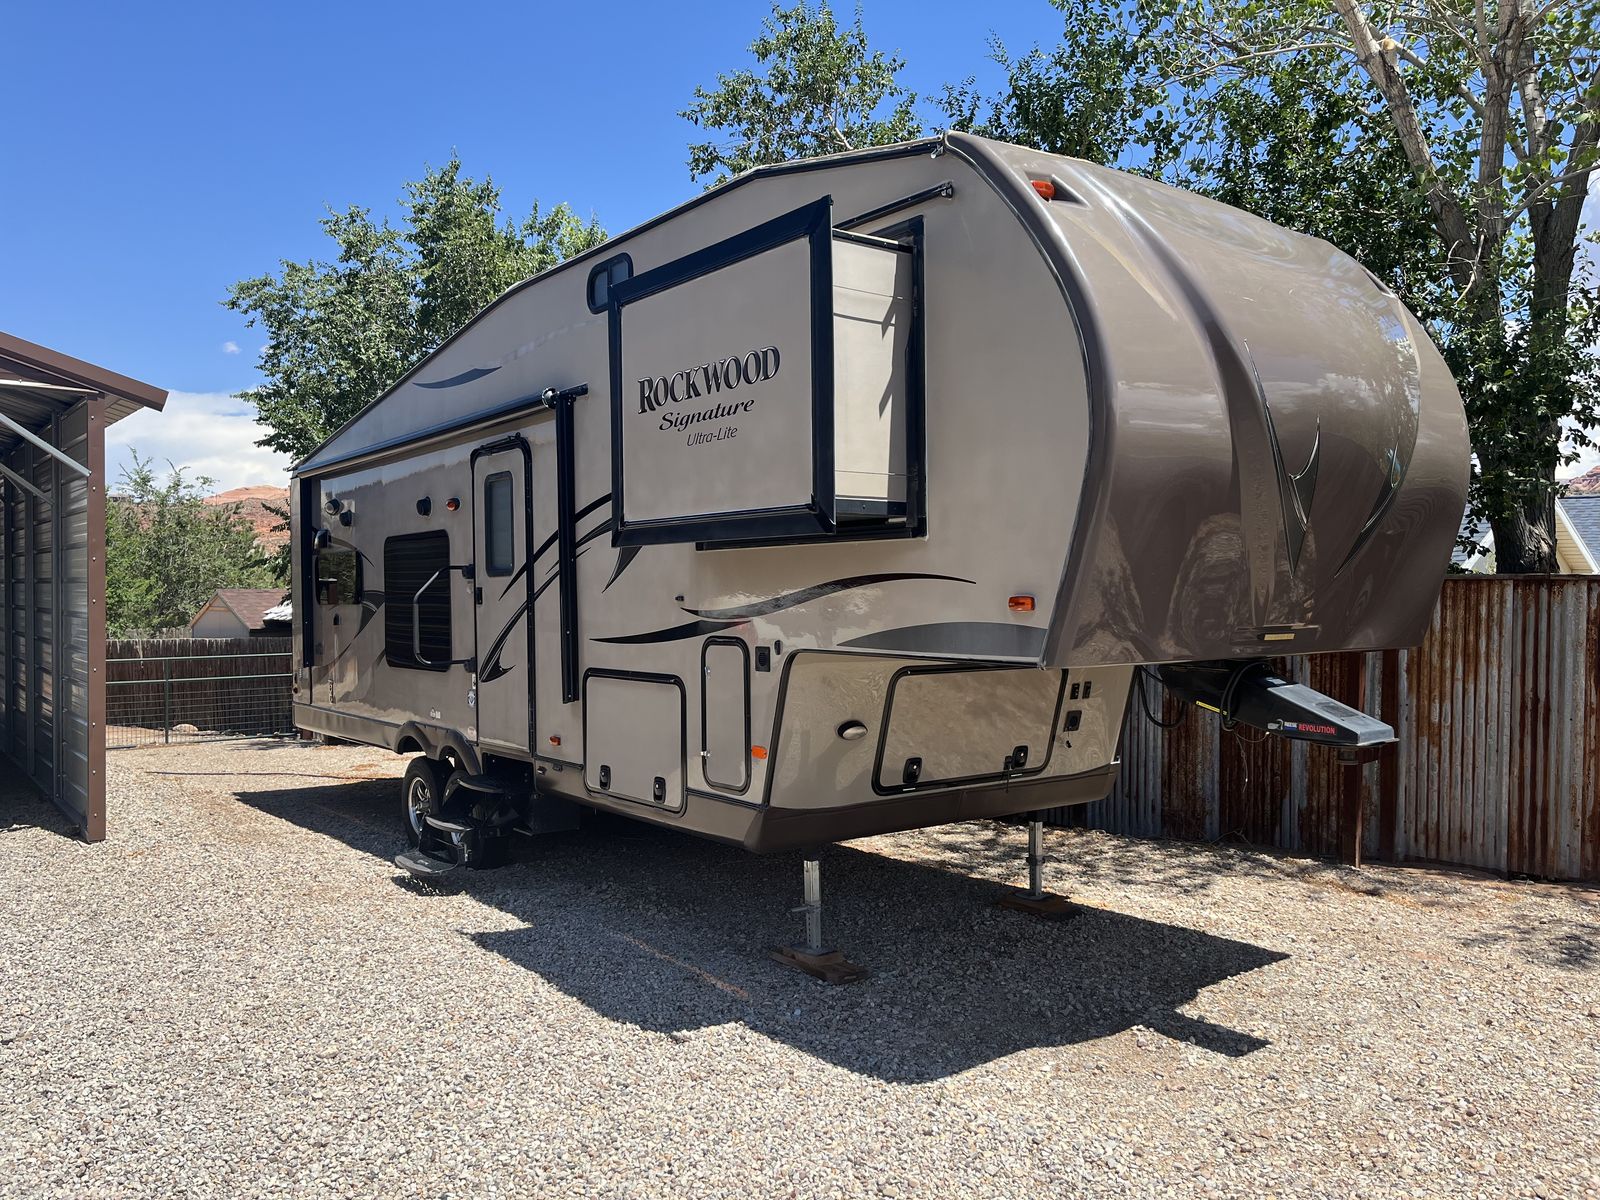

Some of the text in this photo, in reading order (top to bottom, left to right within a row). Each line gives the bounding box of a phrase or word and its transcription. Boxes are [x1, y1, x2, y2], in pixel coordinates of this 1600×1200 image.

[637, 345, 781, 414] ROCKWOOD
[659, 399, 755, 432] Signature
[686, 426, 738, 446] Ultra-Lite
[1298, 723, 1336, 735] REVOLUTION
